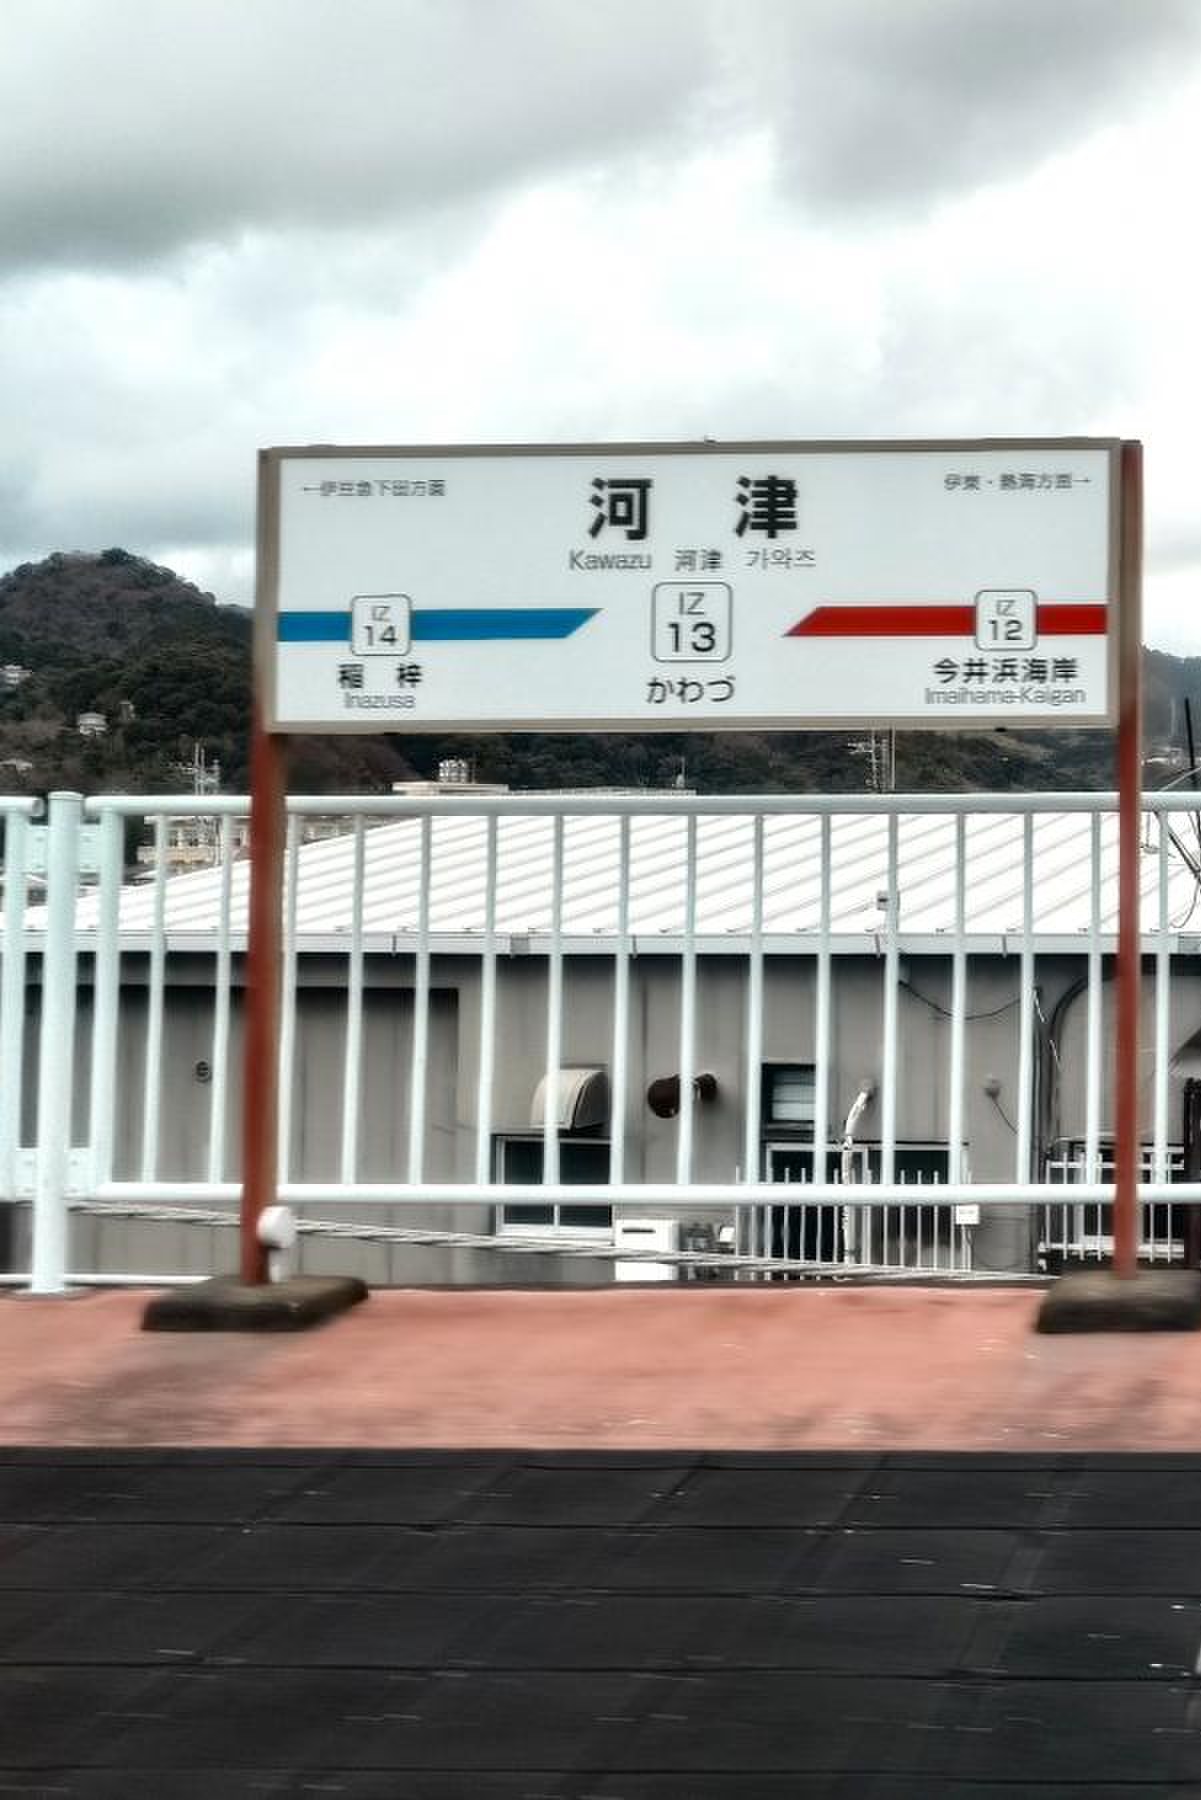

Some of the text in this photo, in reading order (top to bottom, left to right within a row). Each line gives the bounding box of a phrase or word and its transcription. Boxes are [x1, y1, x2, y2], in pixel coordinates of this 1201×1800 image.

[568, 549, 653, 571] Kawazu
[372, 605, 391, 622] IZ
[678, 591, 707, 616] IZ
[995, 599, 1017, 617] IZ
[363, 624, 399, 647] 14
[667, 621, 717, 653] 13
[987, 619, 1024, 641] 12
[932, 657, 1080, 684] 今井浜海岸
[646, 675, 737, 704] かわづ
[924, 687, 1087, 706] Imaihama-Kaigan
[344, 693, 416, 709] Inazusa
